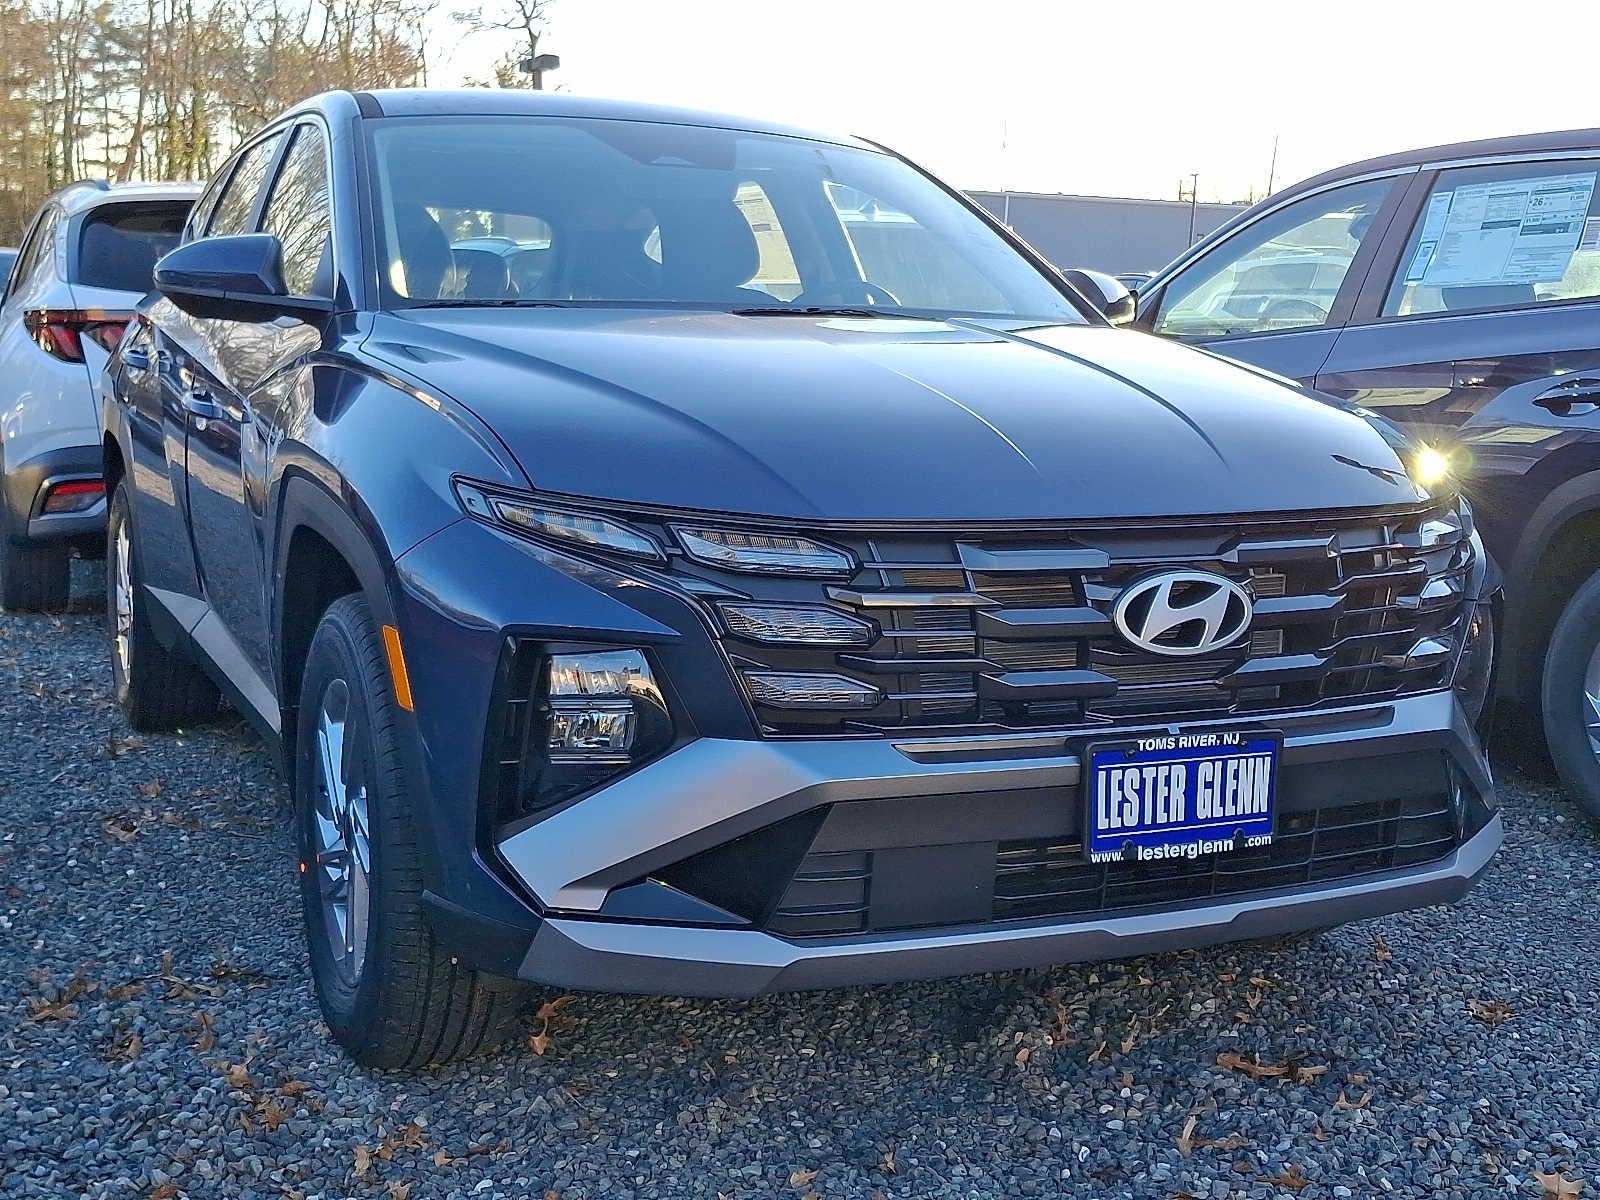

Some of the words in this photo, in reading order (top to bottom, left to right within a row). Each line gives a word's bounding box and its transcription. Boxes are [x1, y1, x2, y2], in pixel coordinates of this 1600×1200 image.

[1532, 197, 1544, 207] 26
[1137, 737, 1176, 752] TOMS
[1178, 734, 1220, 749] RIVER,
[1223, 732, 1240, 746] NJ
[1097, 764, 1187, 830] LESTER
[1196, 756, 1271, 820] GLENN
[1091, 850, 1124, 864] www.
[1137, 838, 1234, 861] lesterglenn
[1244, 835, 1272, 848] .com
